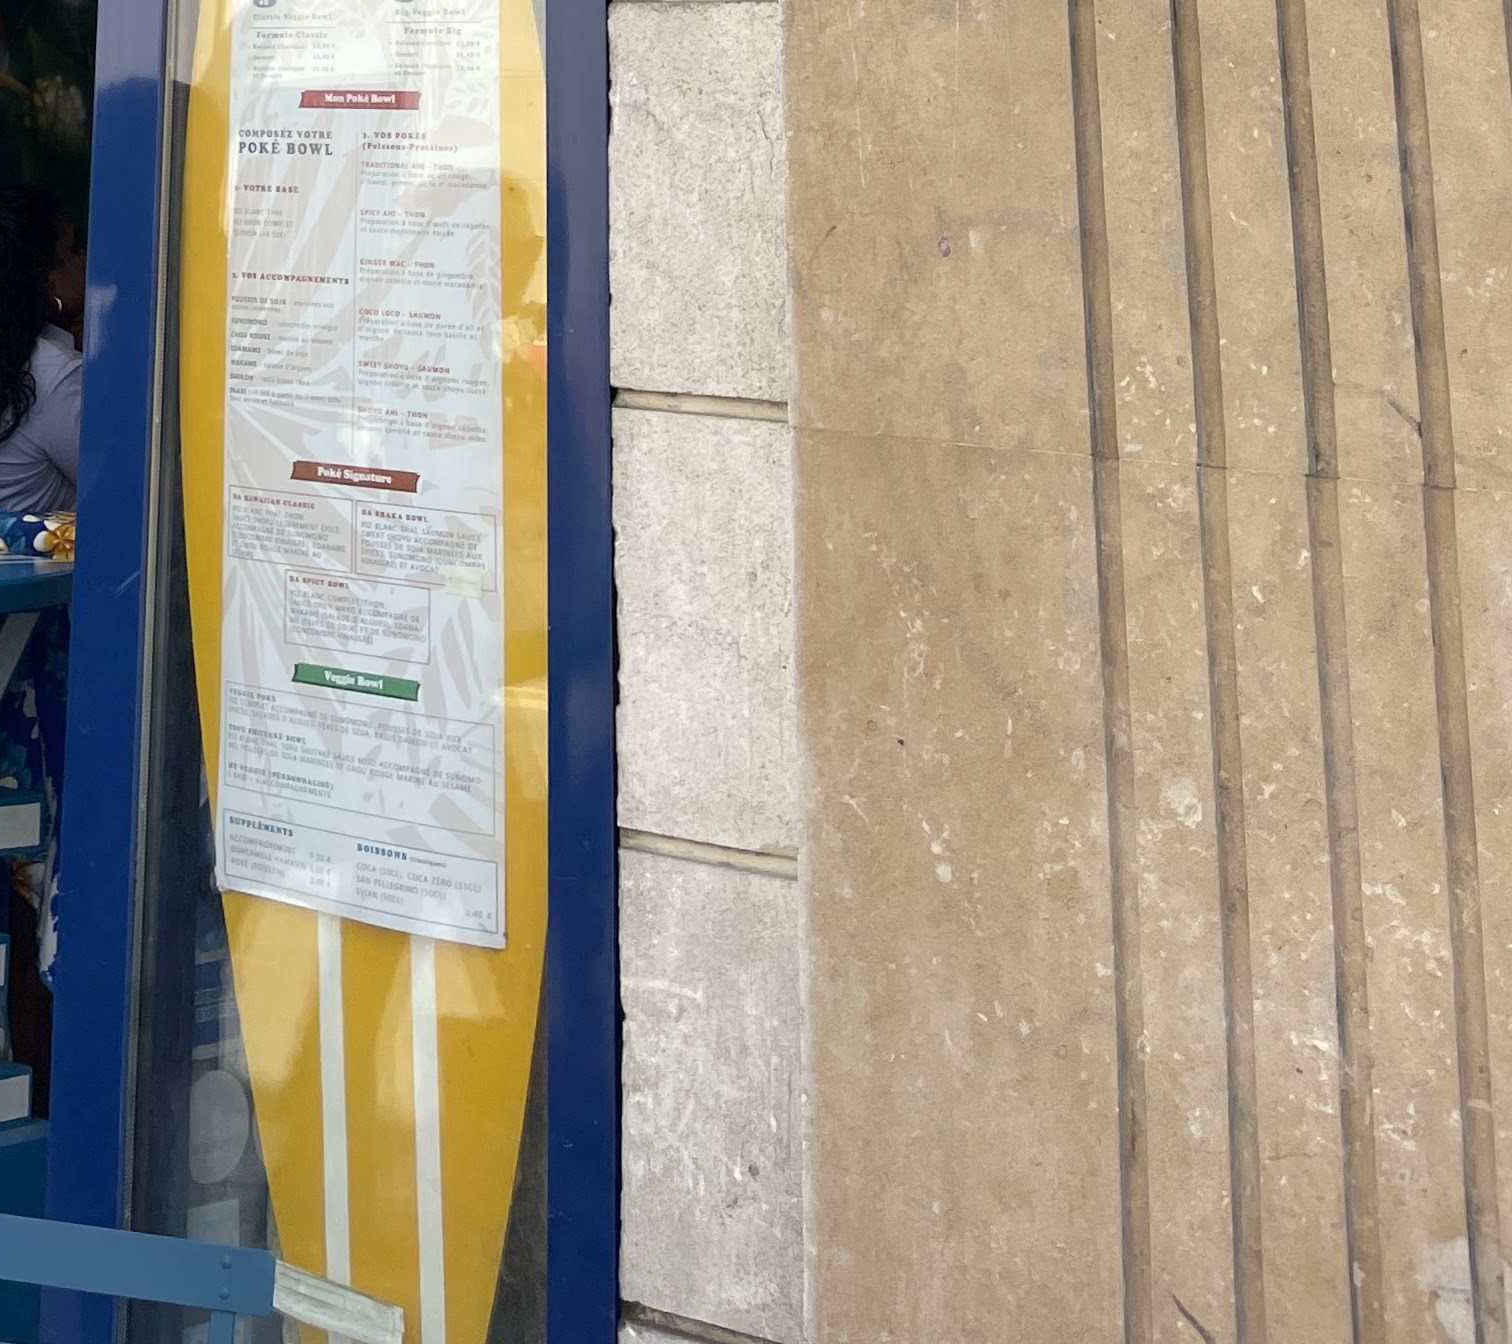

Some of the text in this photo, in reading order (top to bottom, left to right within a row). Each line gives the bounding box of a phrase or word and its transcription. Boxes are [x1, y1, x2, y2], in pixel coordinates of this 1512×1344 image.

[324, 93, 396, 103] Mon Poké Bowl
[238, 129, 333, 139] COMPOSEZ VOTRE
[239, 139, 333, 156] POKÉ BOWL
[242, 272, 257, 280] VOS
[260, 273, 350, 284] ACCOMPAGNEMENTS
[418, 365, 450, 374] SAUMON
[408, 410, 428, 419] THON
[317, 466, 392, 484] Poké Signature
[283, 500, 315, 509] CLASSIC
[406, 513, 428, 523] BOWL
[410, 563, 440, 573] AVOCAT
[302, 577, 325, 586] SPICY
[328, 580, 350, 590] BOWL
[286, 734, 307, 745] BOWL
[442, 743, 473, 753] AVOCAT
[356, 843, 407, 860] BOISSONS
[356, 862, 377, 872] COCA
[407, 872, 428, 884] COCA
[431, 876, 452, 888] ZÉRO
[356, 874, 371, 885] SAN
[373, 878, 419, 894] PELLEGRINO
